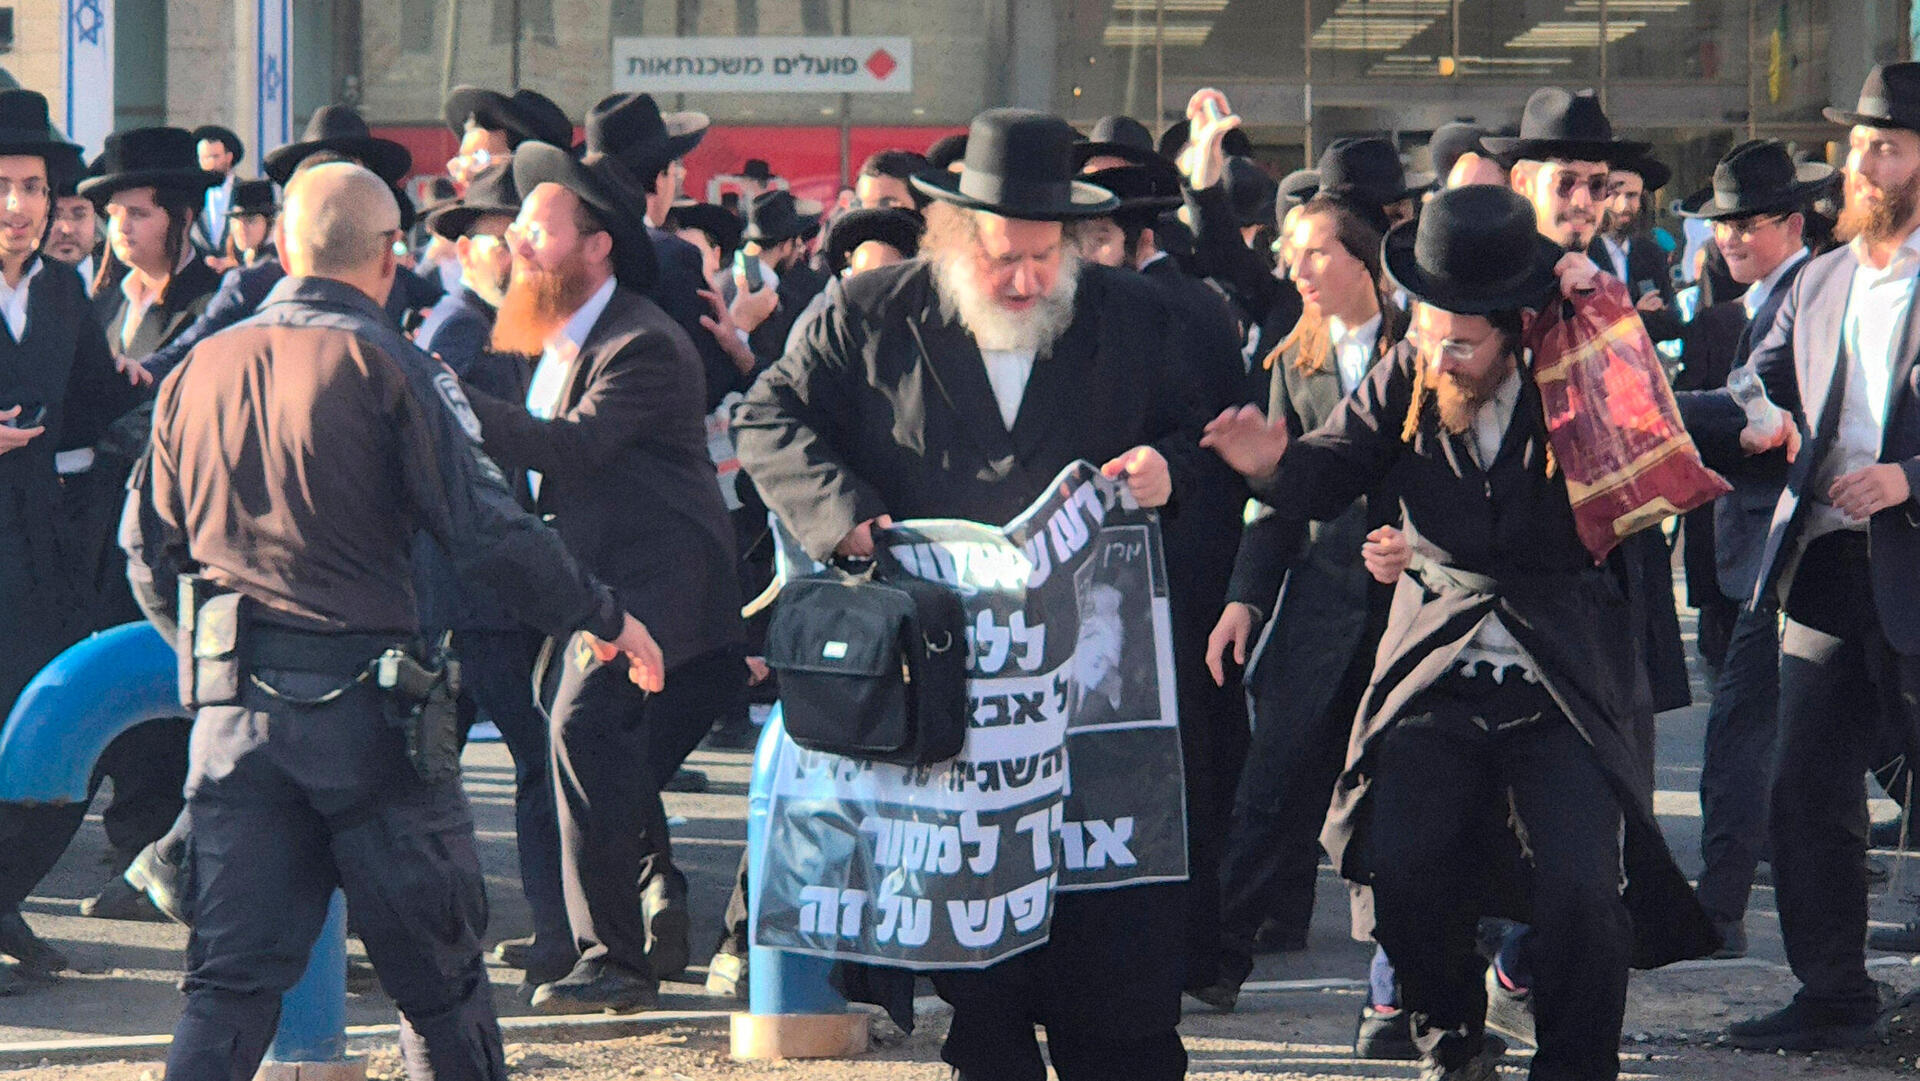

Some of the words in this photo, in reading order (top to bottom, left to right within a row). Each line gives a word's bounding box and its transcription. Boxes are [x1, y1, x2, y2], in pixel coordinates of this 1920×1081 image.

[627, 56, 765, 76] משכנתאות
[774, 53, 859, 76] פועלים
[858, 810, 1000, 875] למסור
[799, 885, 868, 938] זה
[876, 864, 933, 946] על
[946, 871, 1059, 948] פש
